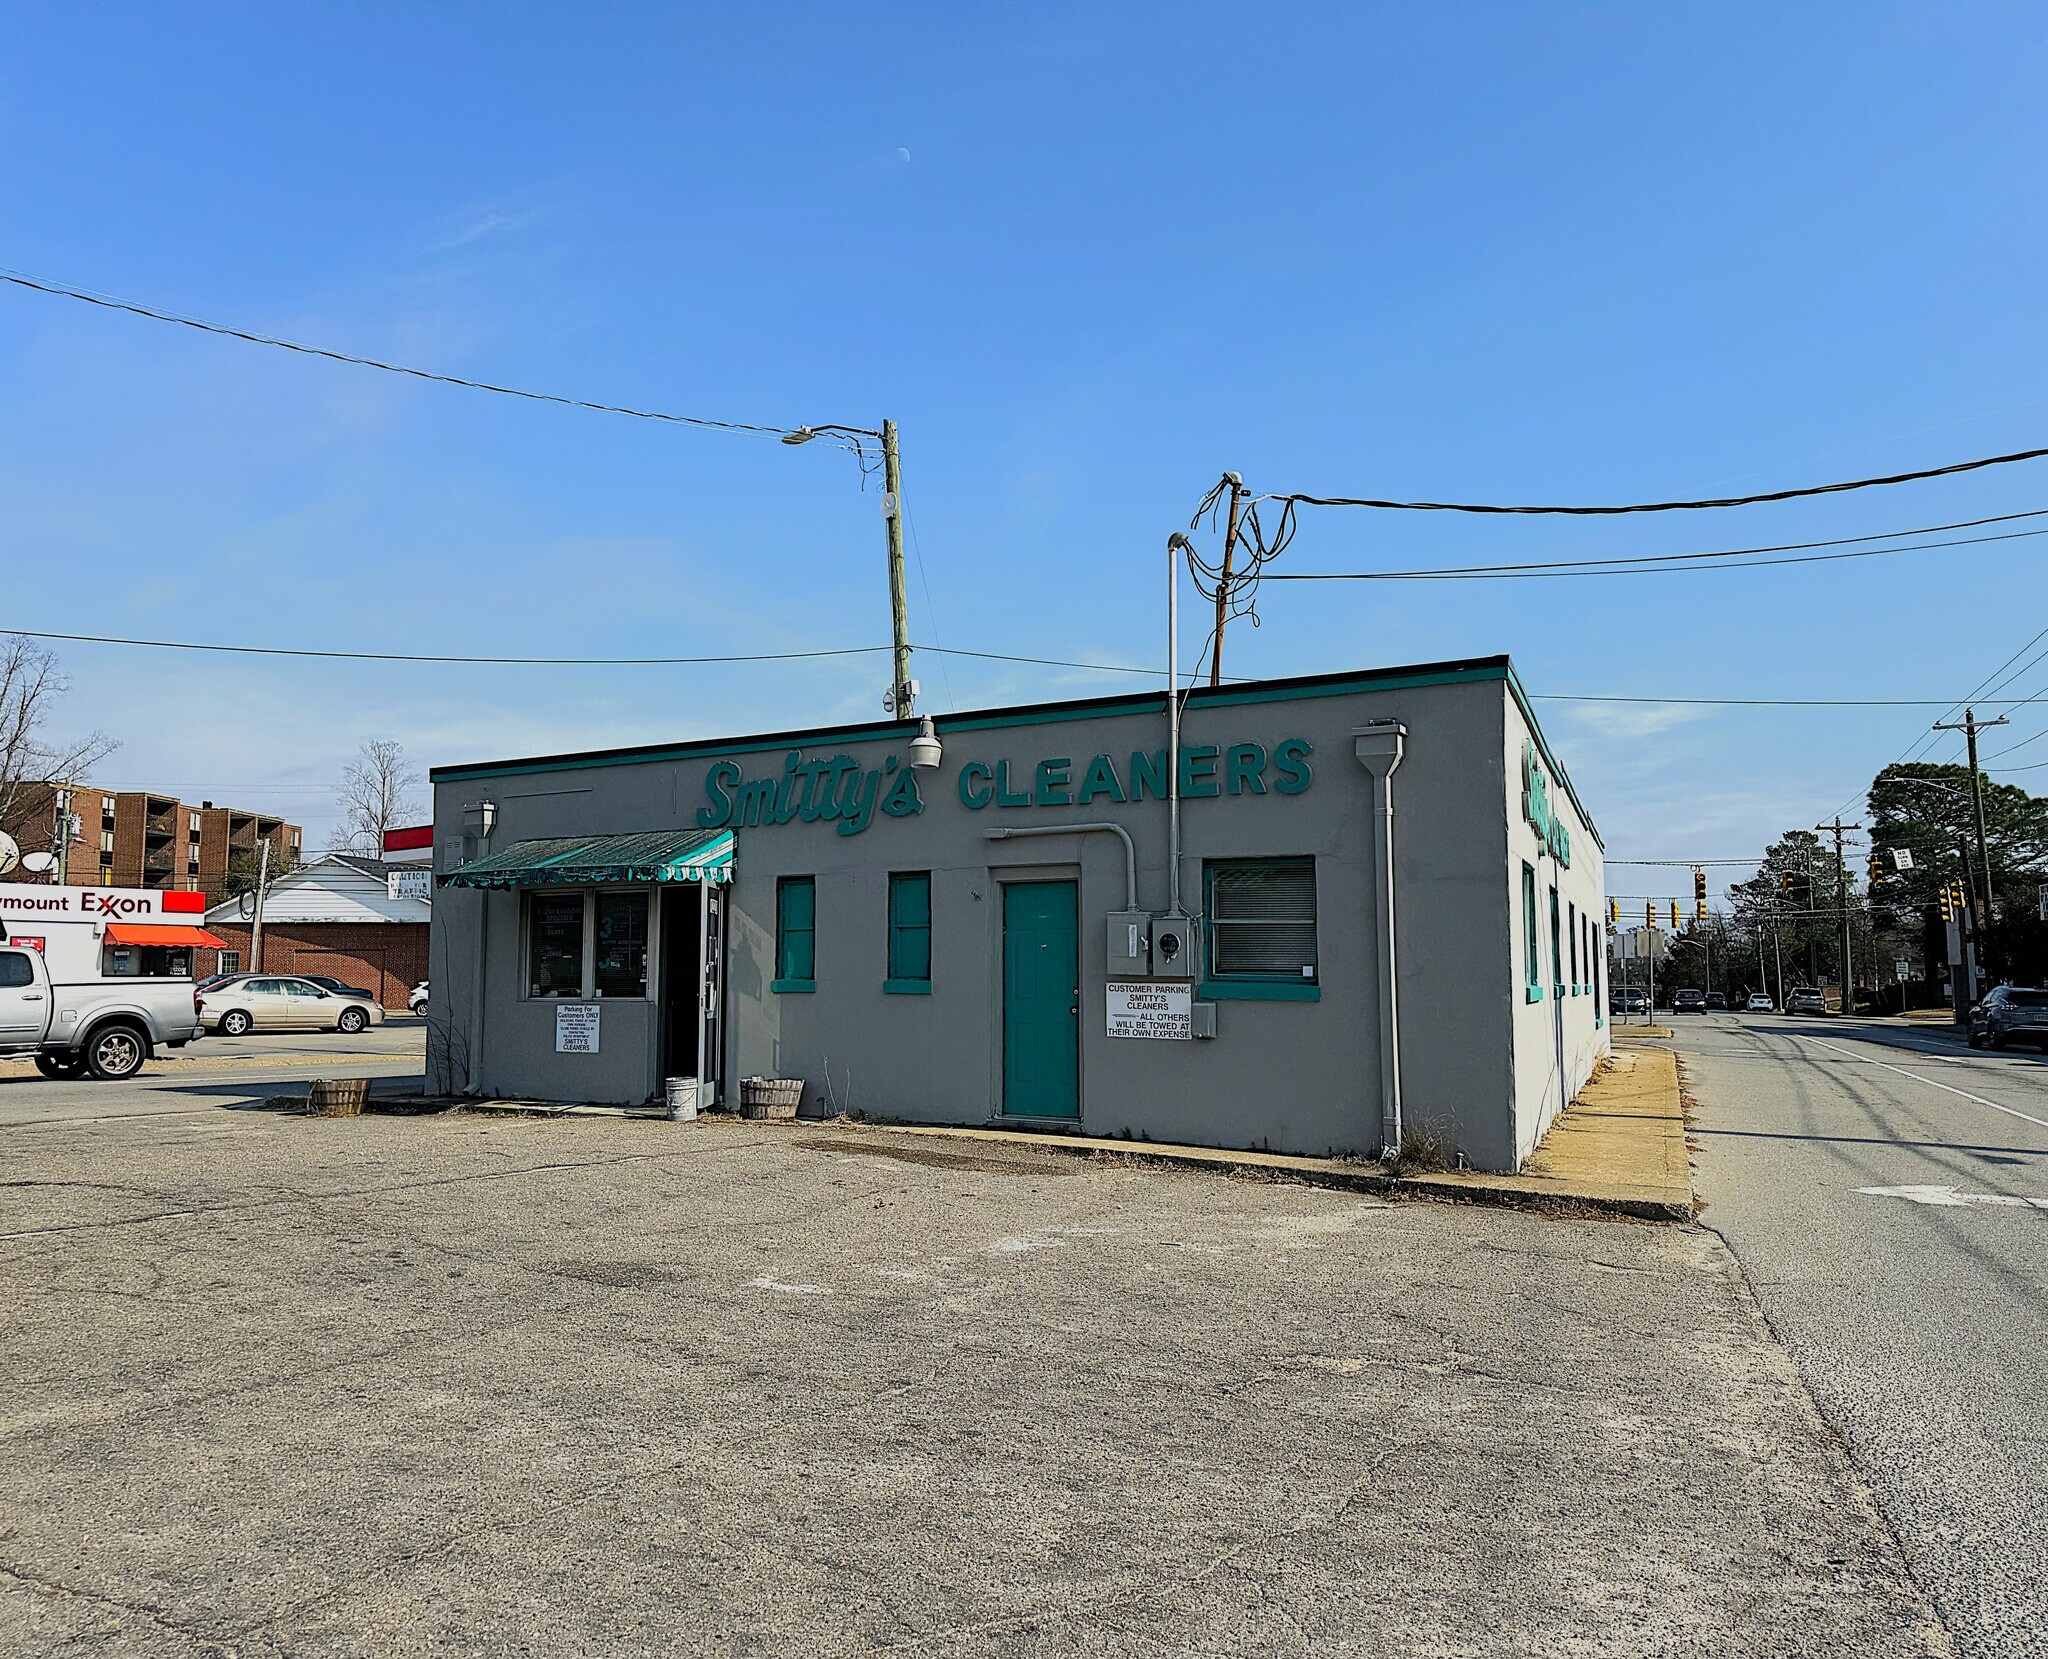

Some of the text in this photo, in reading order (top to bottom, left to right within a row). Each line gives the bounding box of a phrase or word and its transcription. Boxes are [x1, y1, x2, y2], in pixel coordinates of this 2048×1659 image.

[696, 738, 1314, 836] Smitty's CLEANERS
[391, 872, 427, 881] CAUTION
[81, 892, 151, 919] Exxon
[1108, 985, 1190, 994] CUSTOMER PARKING
[1129, 994, 1167, 1003] SMITTY'S
[1127, 1002, 1169, 1010] CLEANERS
[1157, 1014, 1190, 1022] OTHERS
[1136, 1021, 1147, 1029] BE
[1149, 1022, 1177, 1030] TOWED
[1180, 1023, 1190, 1031] AT
[1108, 1028, 1190, 1038] THEIR OWN EXPENSE
